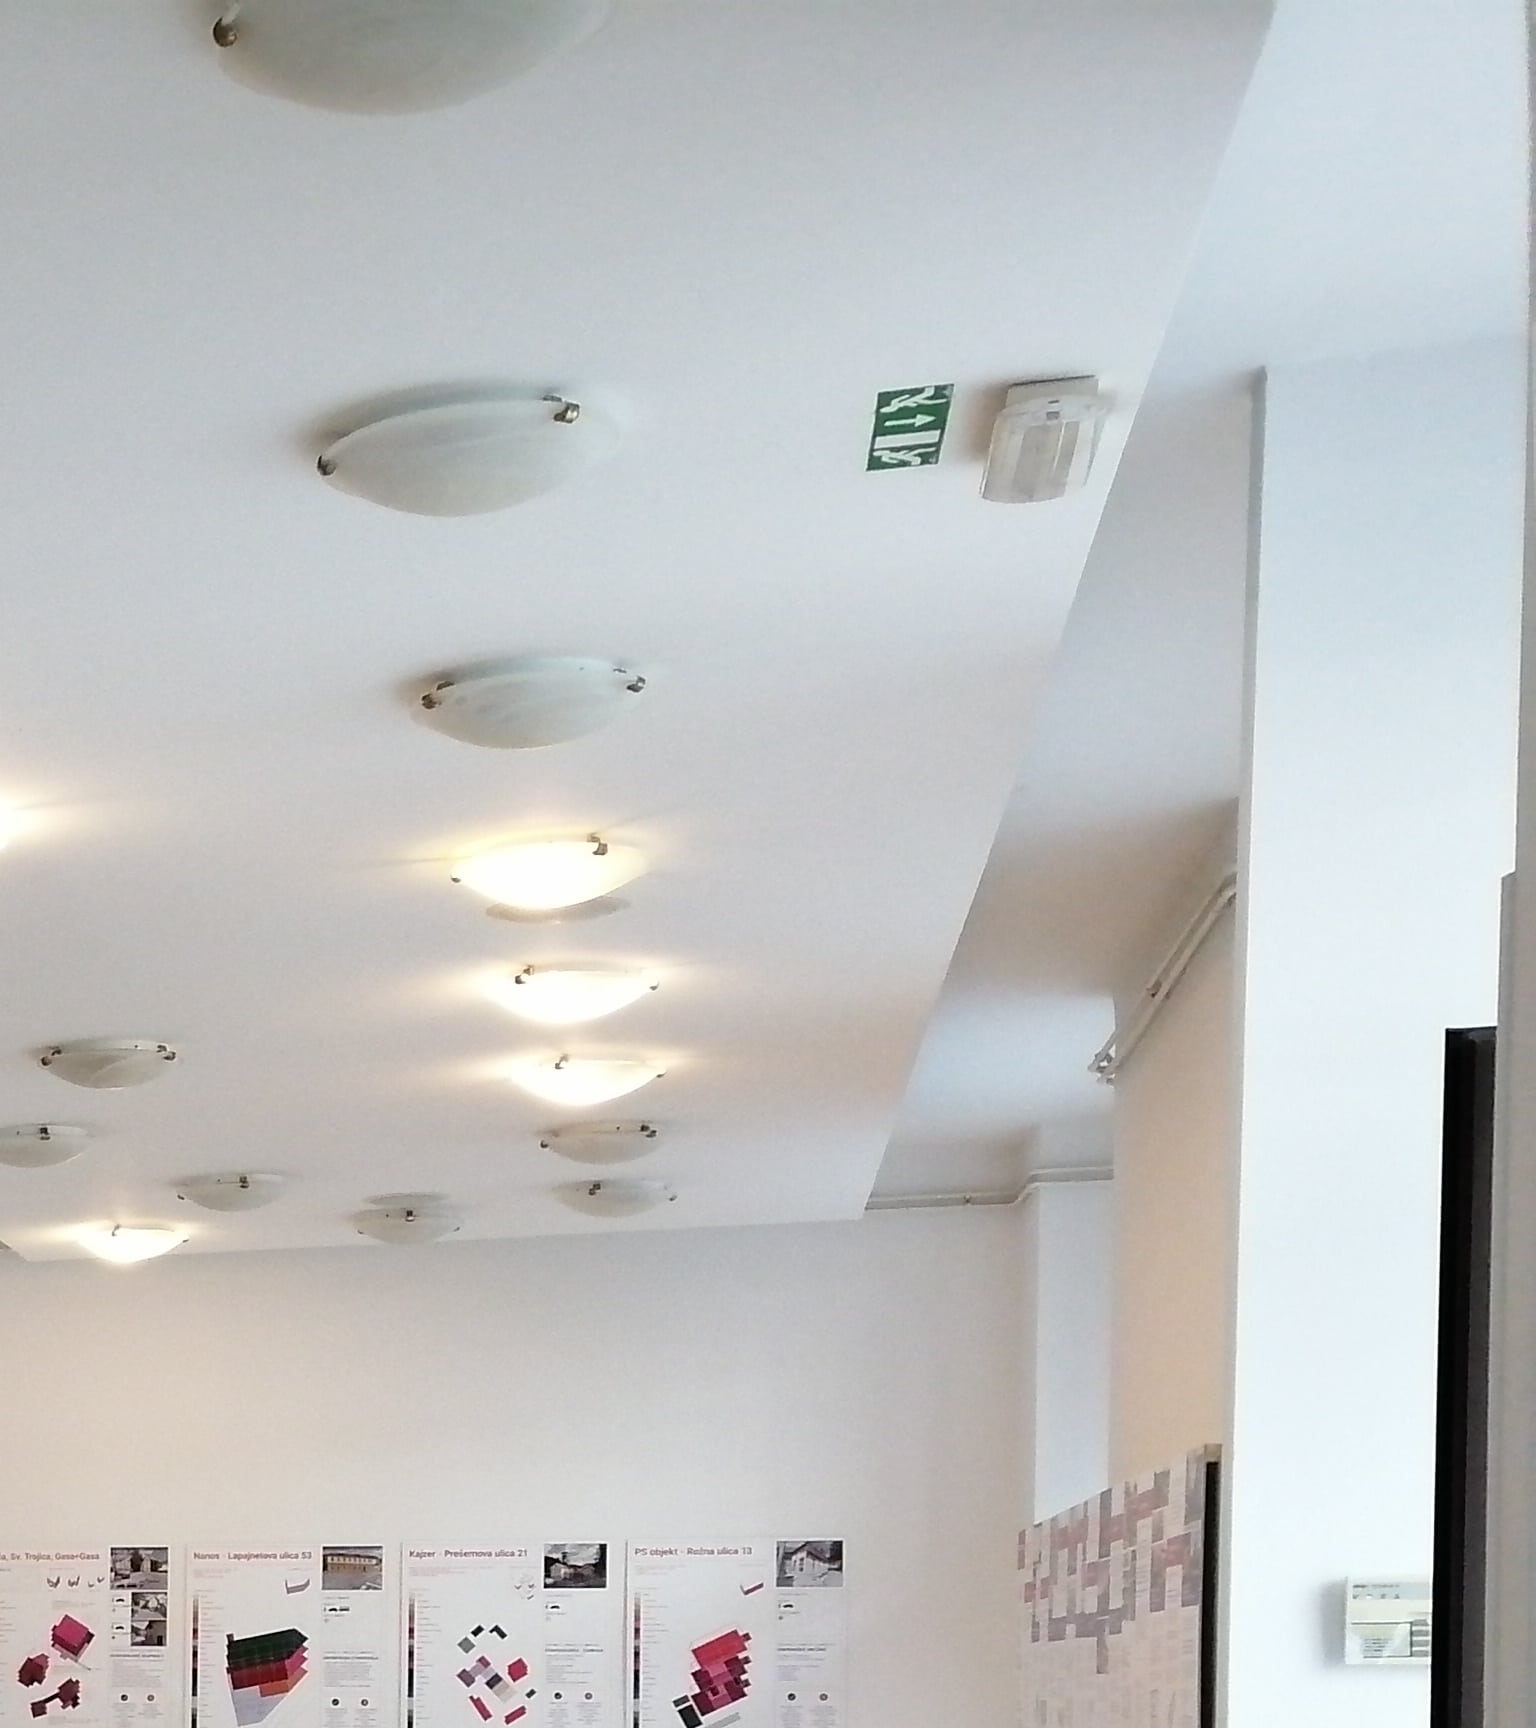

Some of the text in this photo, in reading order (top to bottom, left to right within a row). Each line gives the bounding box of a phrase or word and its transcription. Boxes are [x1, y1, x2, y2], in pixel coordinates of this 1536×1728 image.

[280, 1551, 299, 1560] ulica
[409, 1550, 436, 1559] Kajzer
[494, 1550, 515, 1558] ulica
[517, 1549, 528, 1557] 21
[634, 1548, 648, 1556] PS
[650, 1548, 678, 1557] objekt
[717, 1546, 739, 1555] ulica
